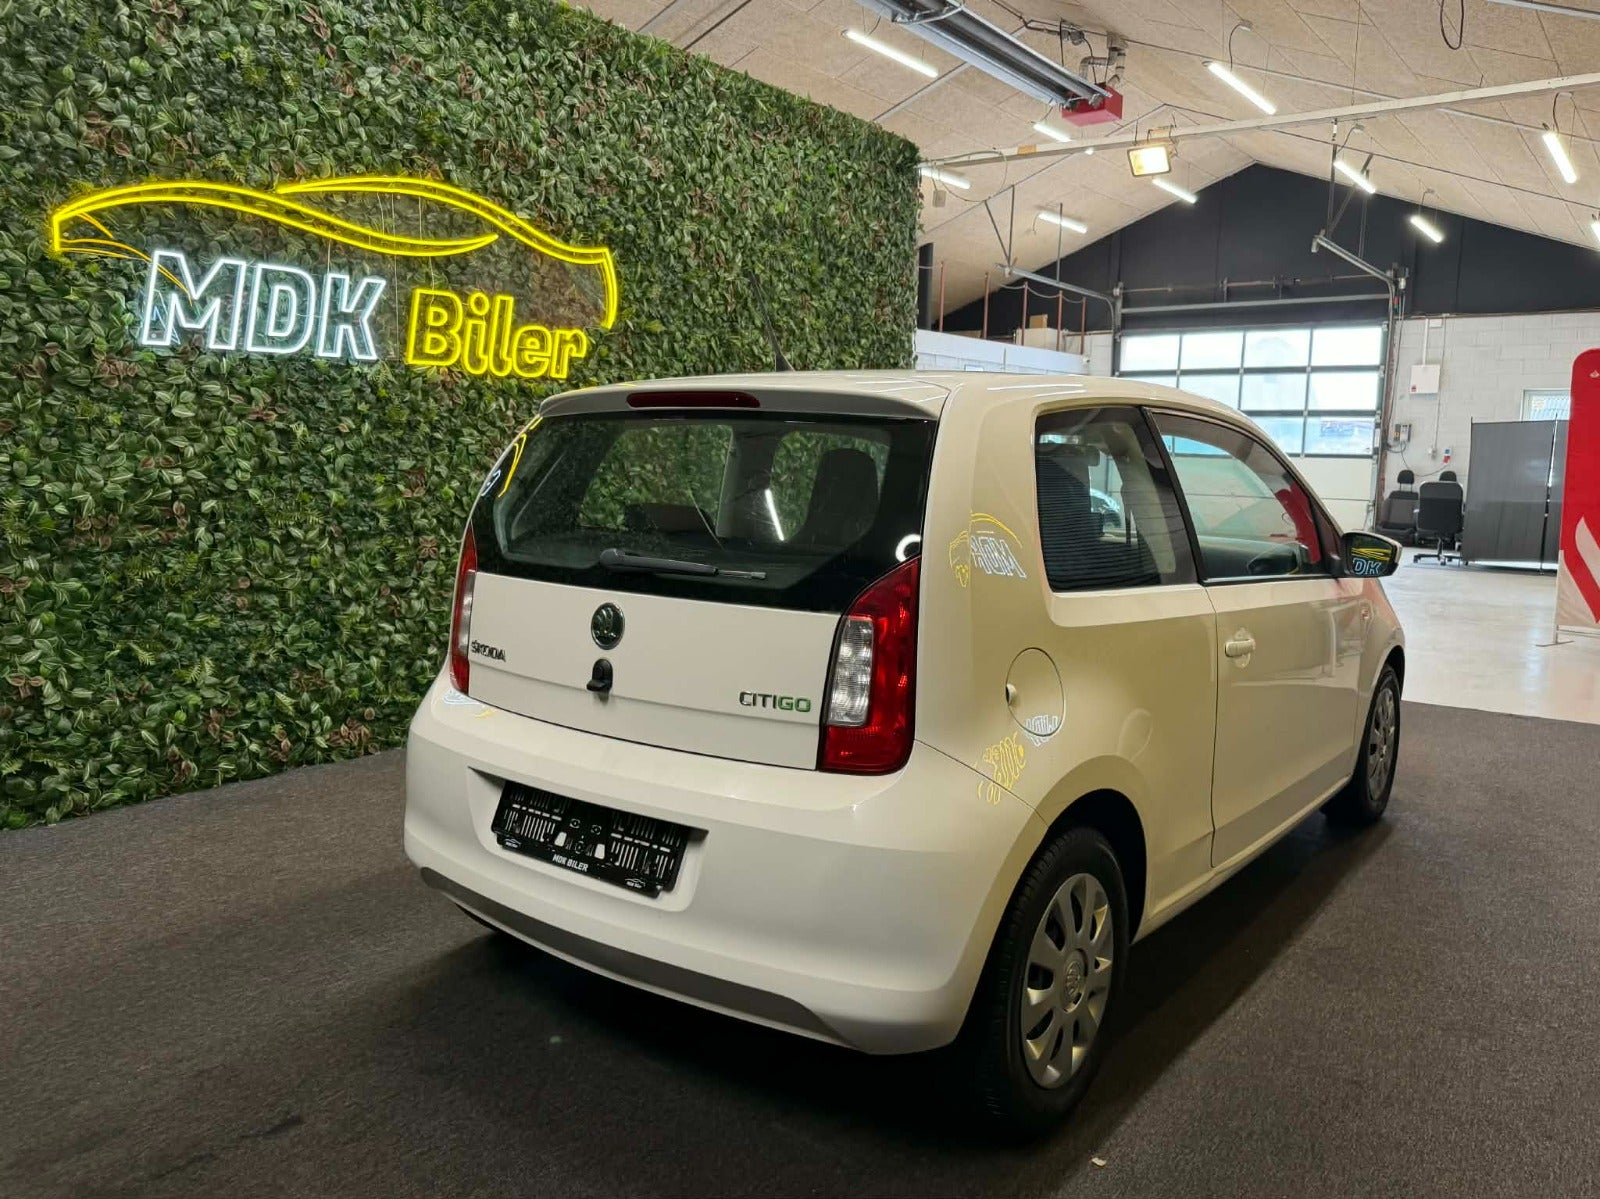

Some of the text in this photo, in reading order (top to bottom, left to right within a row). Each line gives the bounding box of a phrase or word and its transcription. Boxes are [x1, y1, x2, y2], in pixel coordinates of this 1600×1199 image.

[142, 249, 588, 379] MDK Biler
[739, 691, 811, 712] CITIGO
[552, 854, 588, 872] MDK BILER
